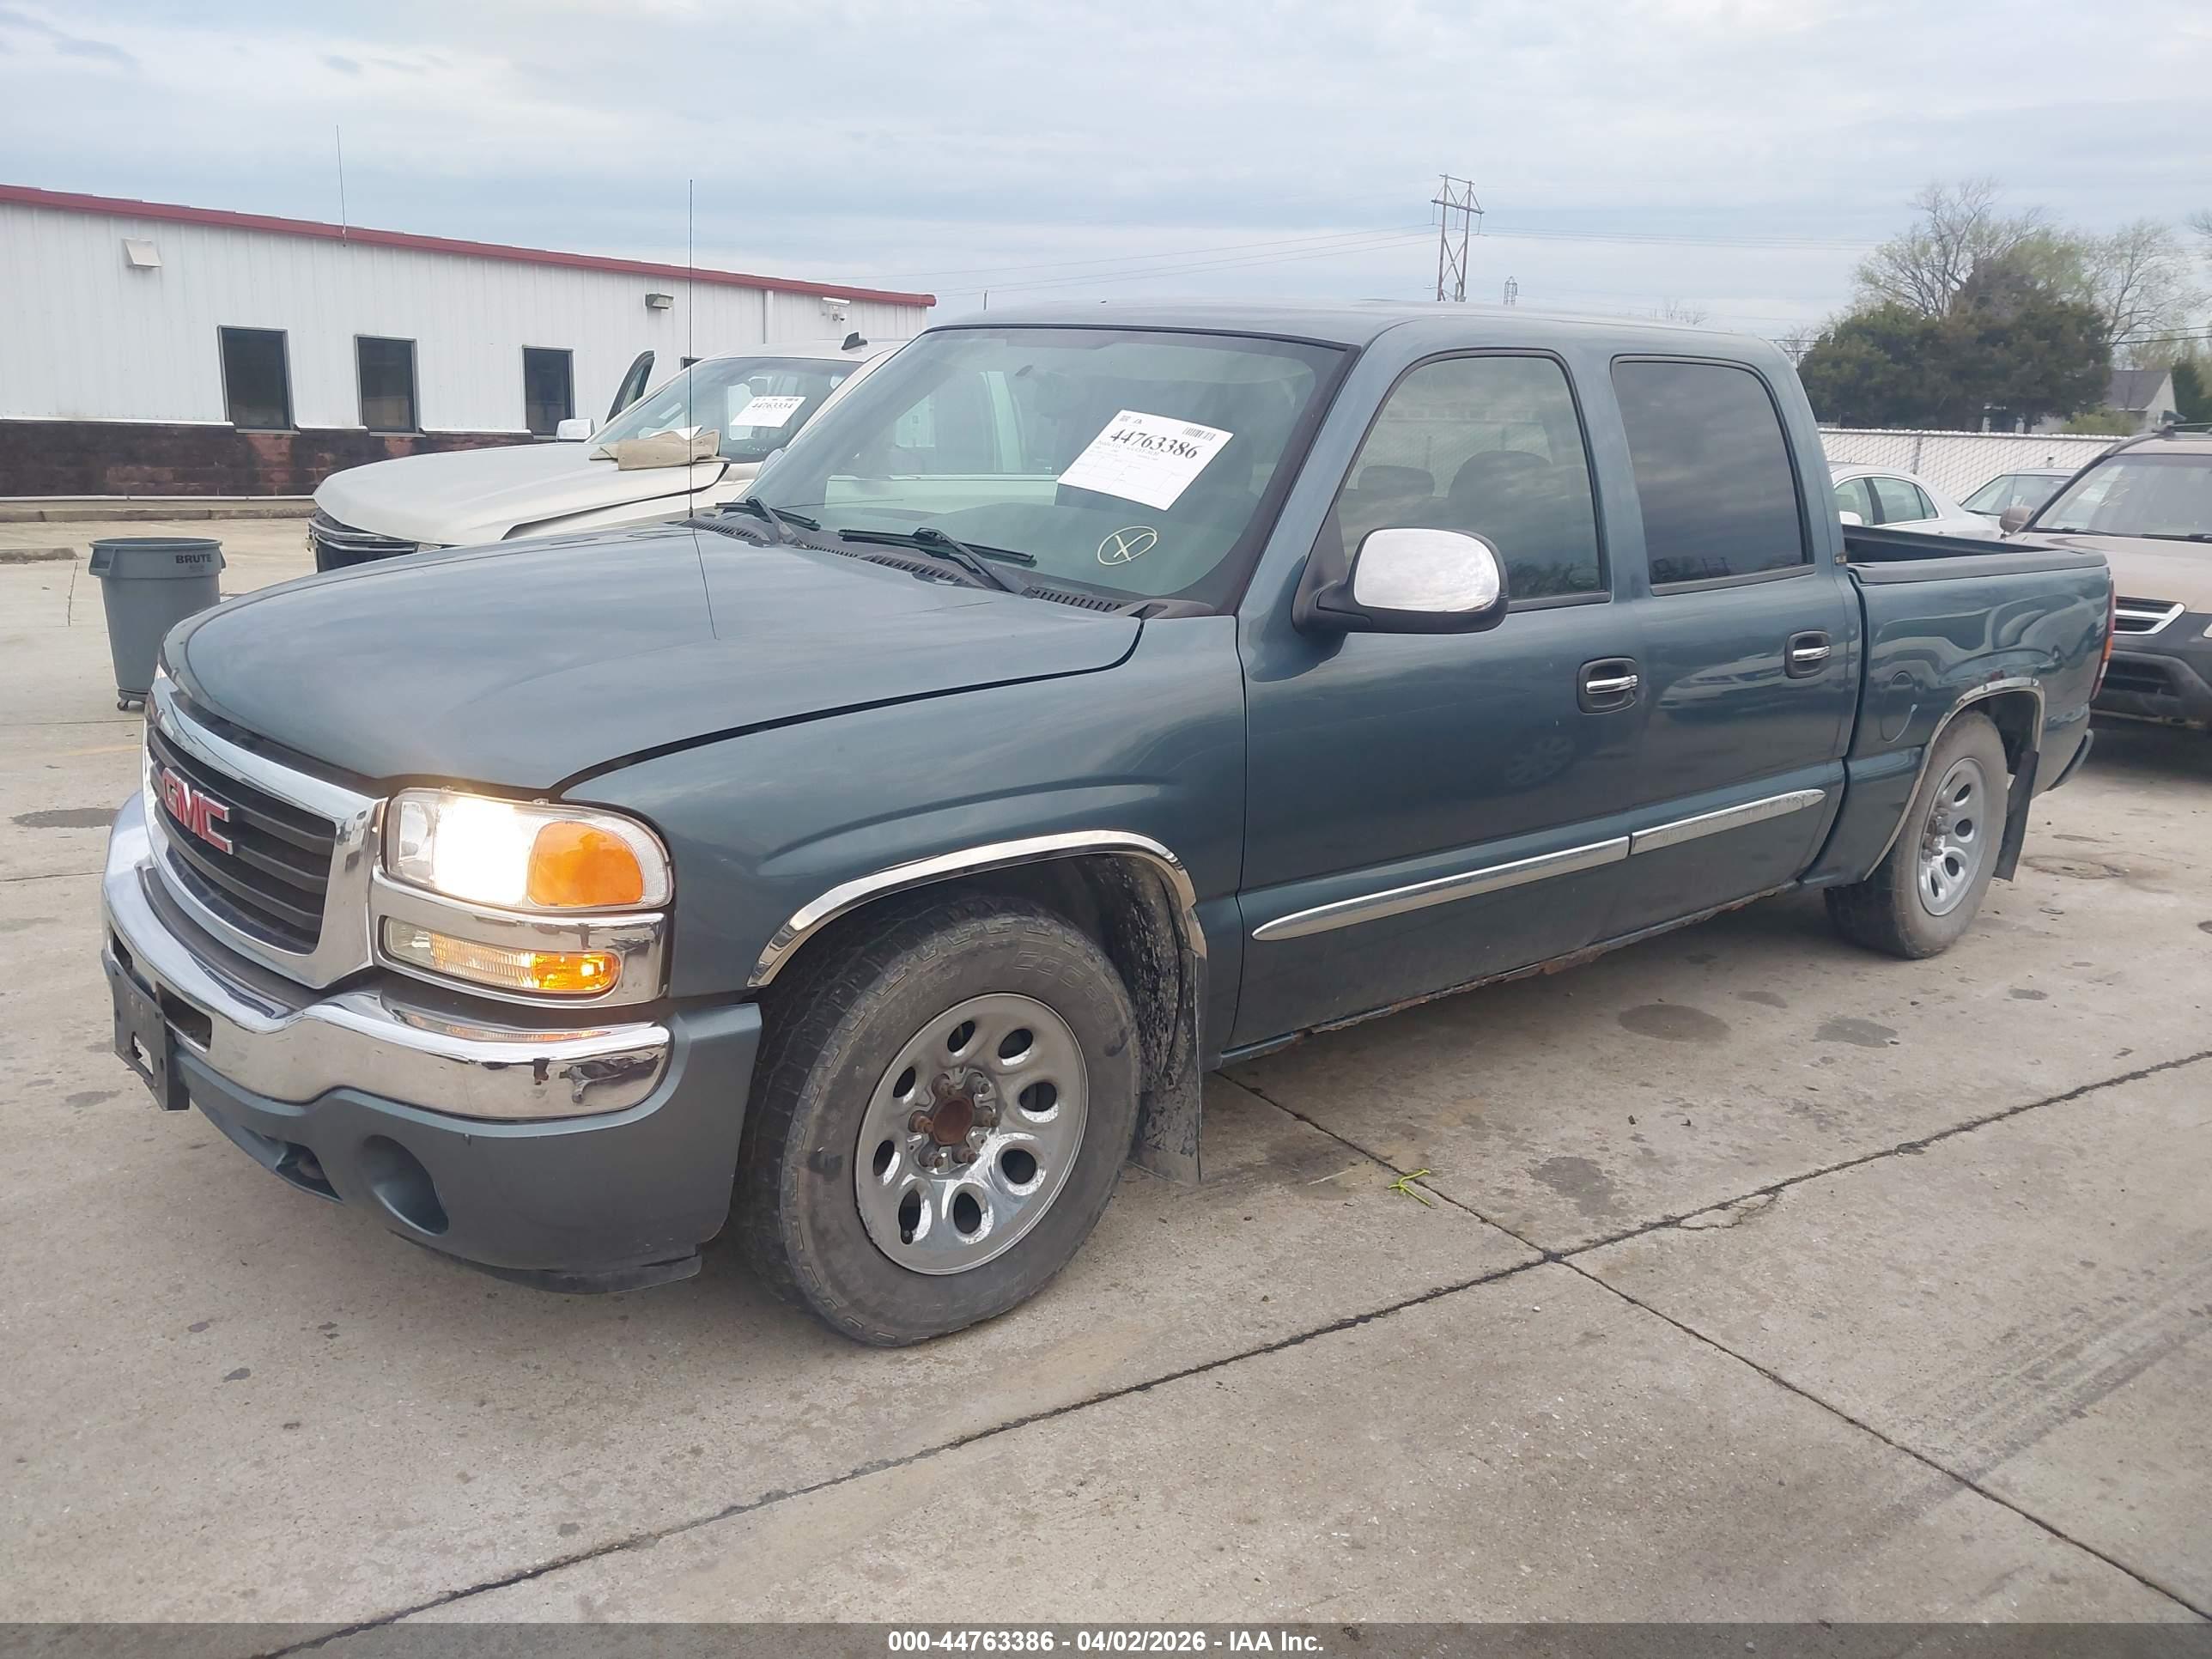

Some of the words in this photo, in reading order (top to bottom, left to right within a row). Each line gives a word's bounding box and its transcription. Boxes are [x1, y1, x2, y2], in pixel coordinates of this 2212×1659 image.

[1109, 428, 1203, 459] 44763386
[176, 554, 212, 563] BRUTE
[162, 767, 234, 855] GMC
